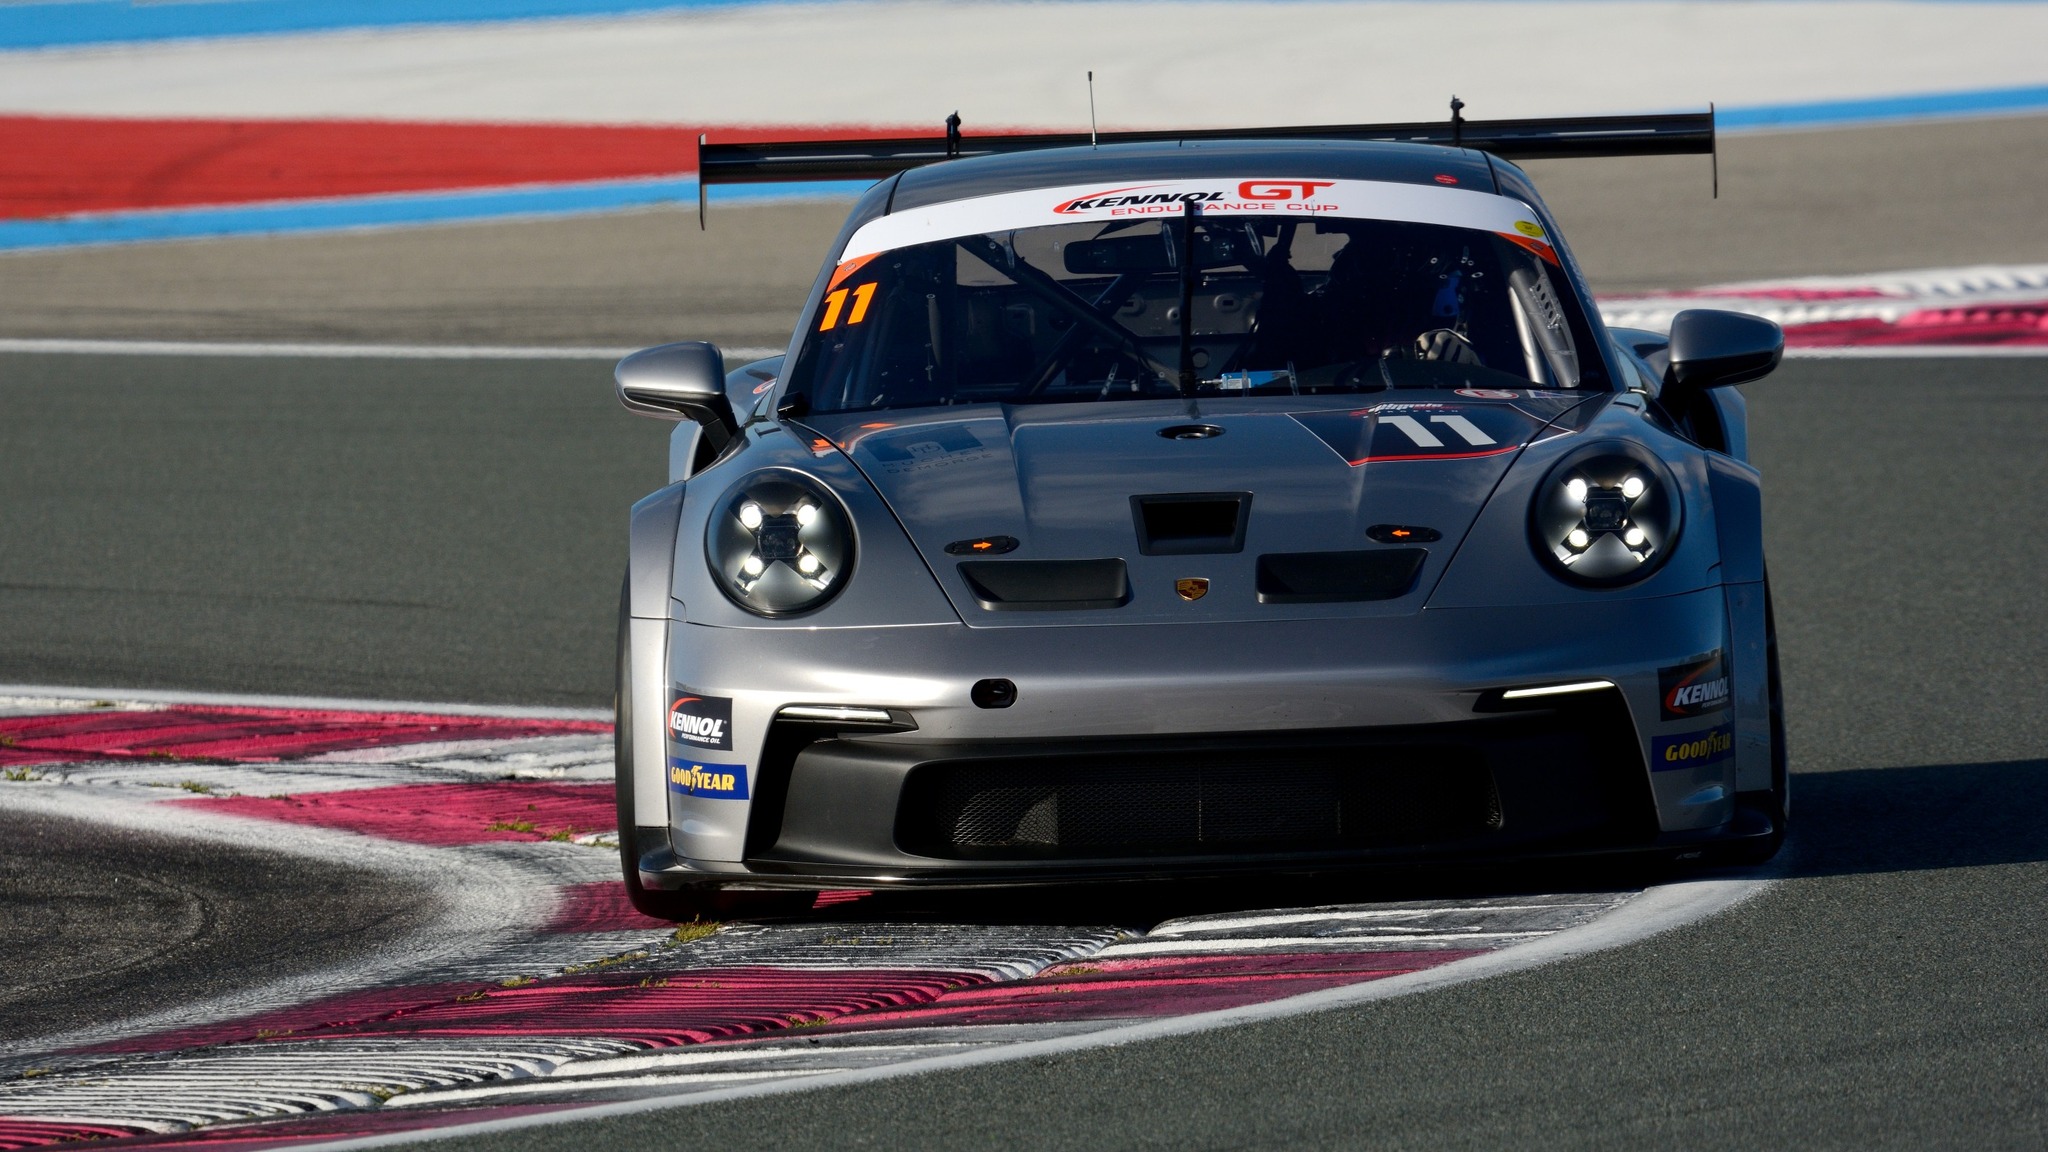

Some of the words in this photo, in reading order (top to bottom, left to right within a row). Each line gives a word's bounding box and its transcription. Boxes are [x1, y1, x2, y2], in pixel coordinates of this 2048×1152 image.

[1066, 191, 1225, 211] KENNOL
[1238, 180, 1336, 200] GT
[1286, 203, 1339, 212] CUP
[819, 282, 878, 332] 11
[1378, 415, 1497, 447] 11
[1673, 676, 1728, 706] KENNOL
[670, 711, 723, 737] KENNOL
[1665, 731, 1731, 762] GOODYEAR
[671, 765, 735, 791] GOODYEAR
